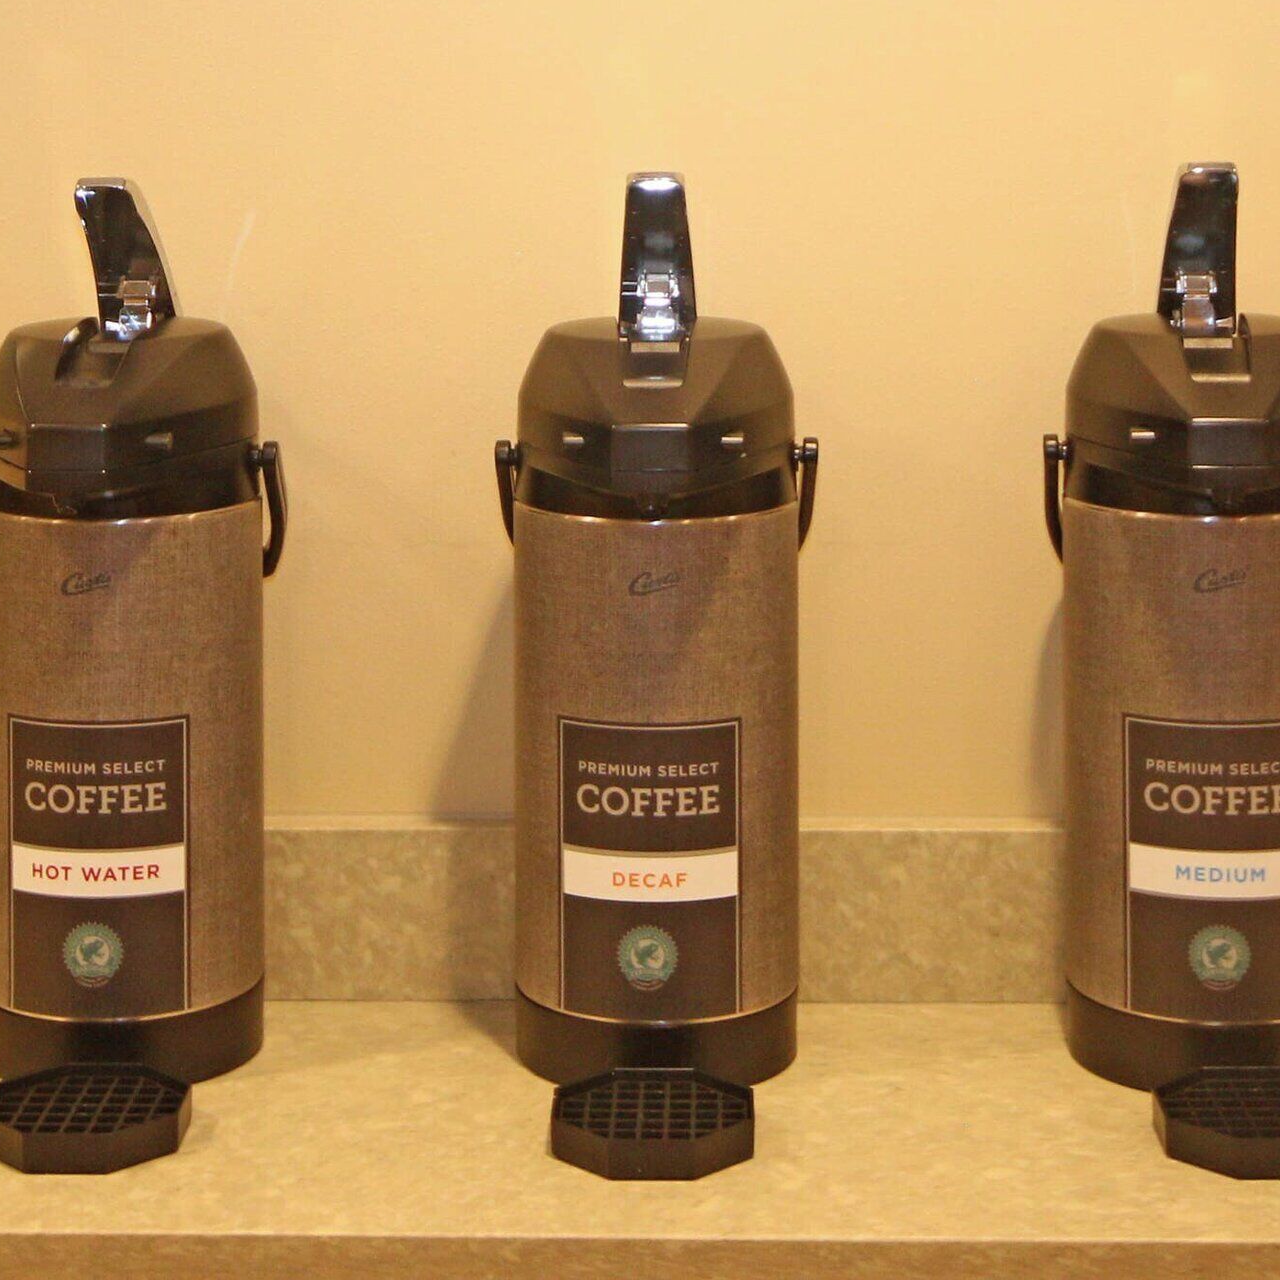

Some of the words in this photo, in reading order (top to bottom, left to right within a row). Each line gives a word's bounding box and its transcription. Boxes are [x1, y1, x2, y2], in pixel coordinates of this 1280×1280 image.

[26, 758, 96, 775] PREMIUM
[102, 759, 166, 775] SELECT
[578, 760, 651, 777] PREMIUM
[657, 761, 719, 777] SELECT
[1146, 758, 1223, 776] PREMIUM
[25, 781, 167, 815] COFFEE
[576, 783, 720, 817] COFFEE
[32, 863, 72, 881] HOT
[81, 864, 160, 882] WATER
[612, 871, 688, 888] DECAF
[1175, 864, 1266, 883] MEDIUM
